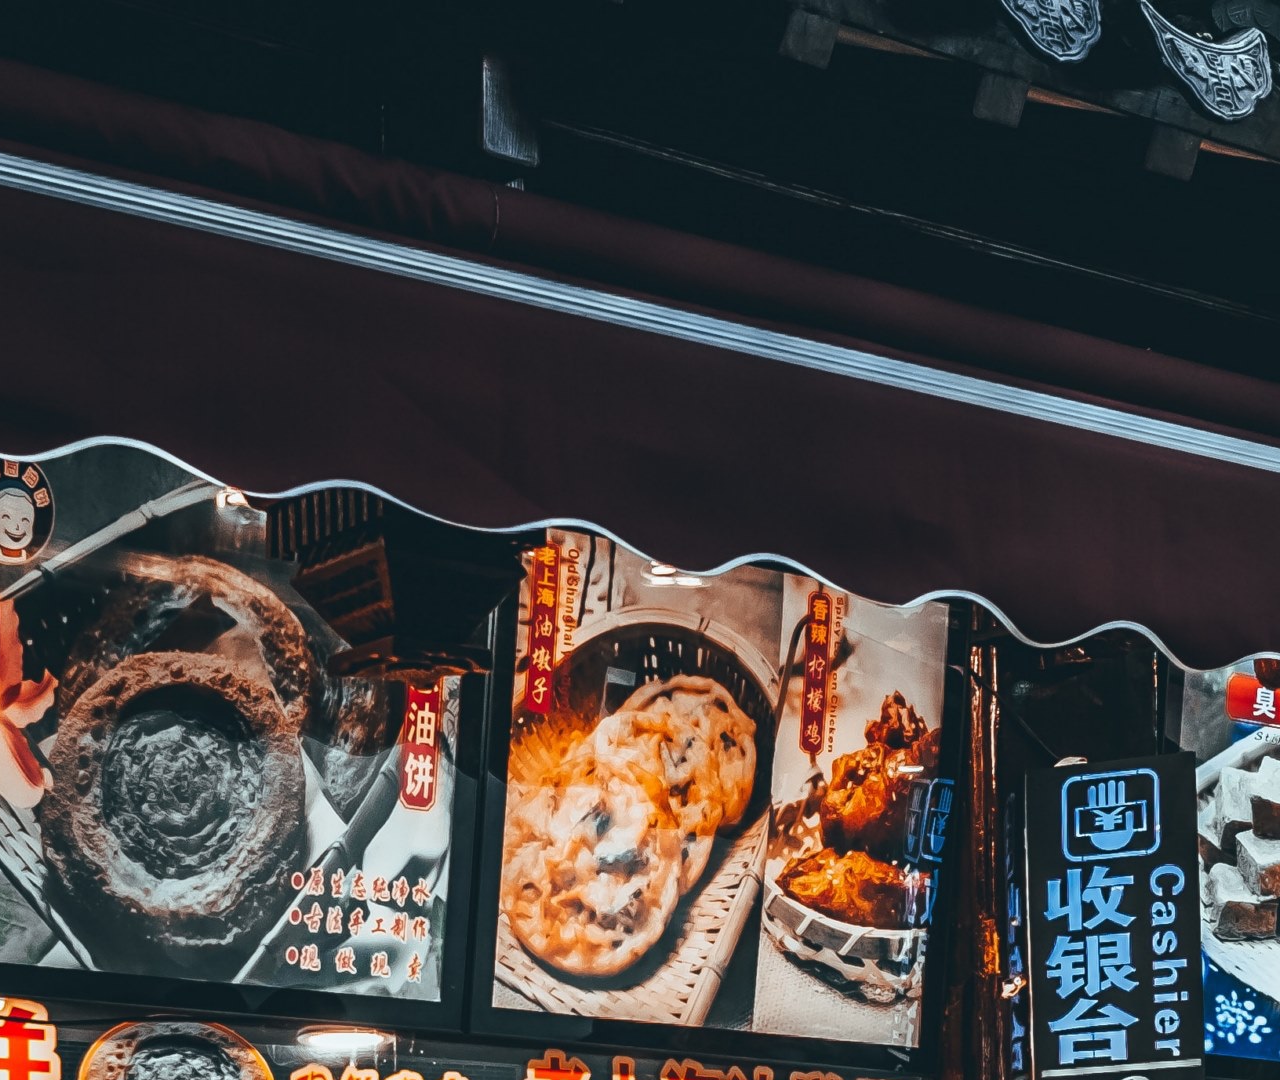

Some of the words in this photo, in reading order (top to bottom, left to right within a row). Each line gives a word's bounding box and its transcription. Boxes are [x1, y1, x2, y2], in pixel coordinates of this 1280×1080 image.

[531, 546, 558, 705] 老上海油墩子
[804, 599, 829, 745] 香辣柠檬鸡
[404, 701, 436, 800] 油饼
[827, 694, 839, 753] Chicken
[299, 947, 423, 983] 现做现卖
[302, 907, 430, 944] 古法手工制作
[1043, 866, 1140, 1065] 收银台
[1149, 864, 1189, 1057] Cashier
